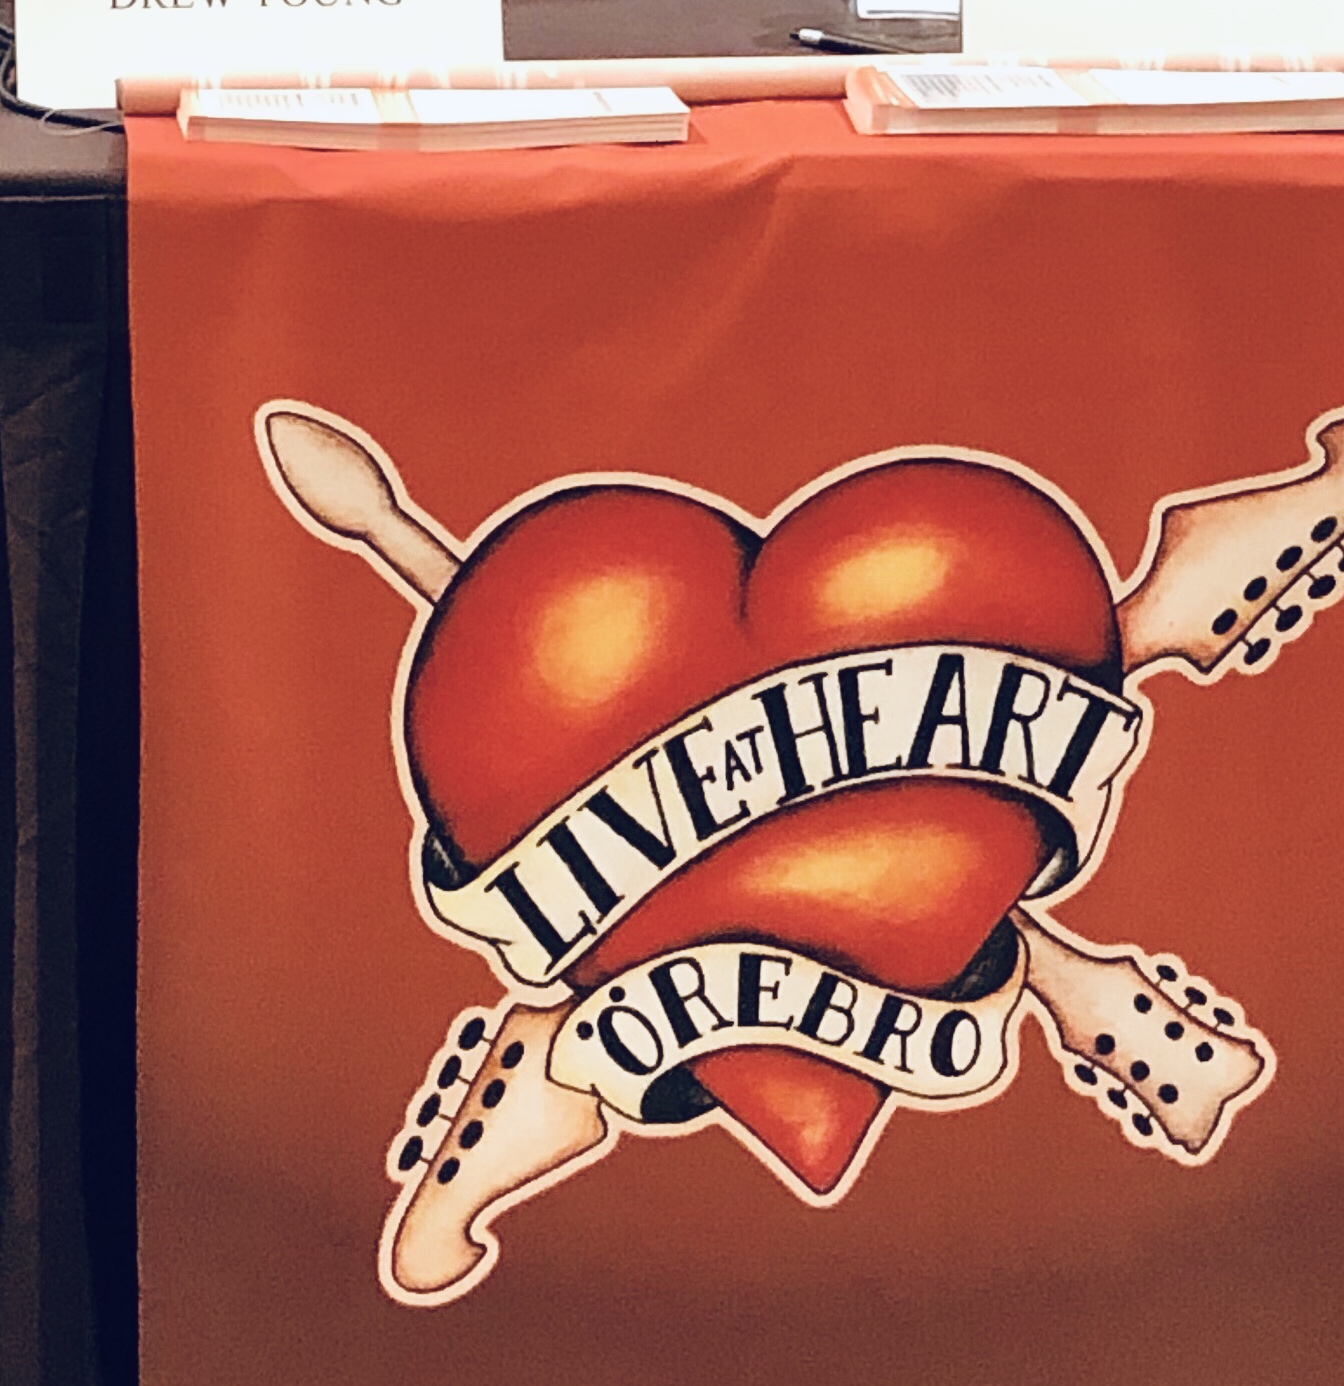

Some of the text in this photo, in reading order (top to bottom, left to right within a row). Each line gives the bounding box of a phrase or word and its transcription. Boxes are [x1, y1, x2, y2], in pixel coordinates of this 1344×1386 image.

[485, 653, 1140, 974] LIVE AT HEART
[576, 952, 982, 1078] ÖREBRO
